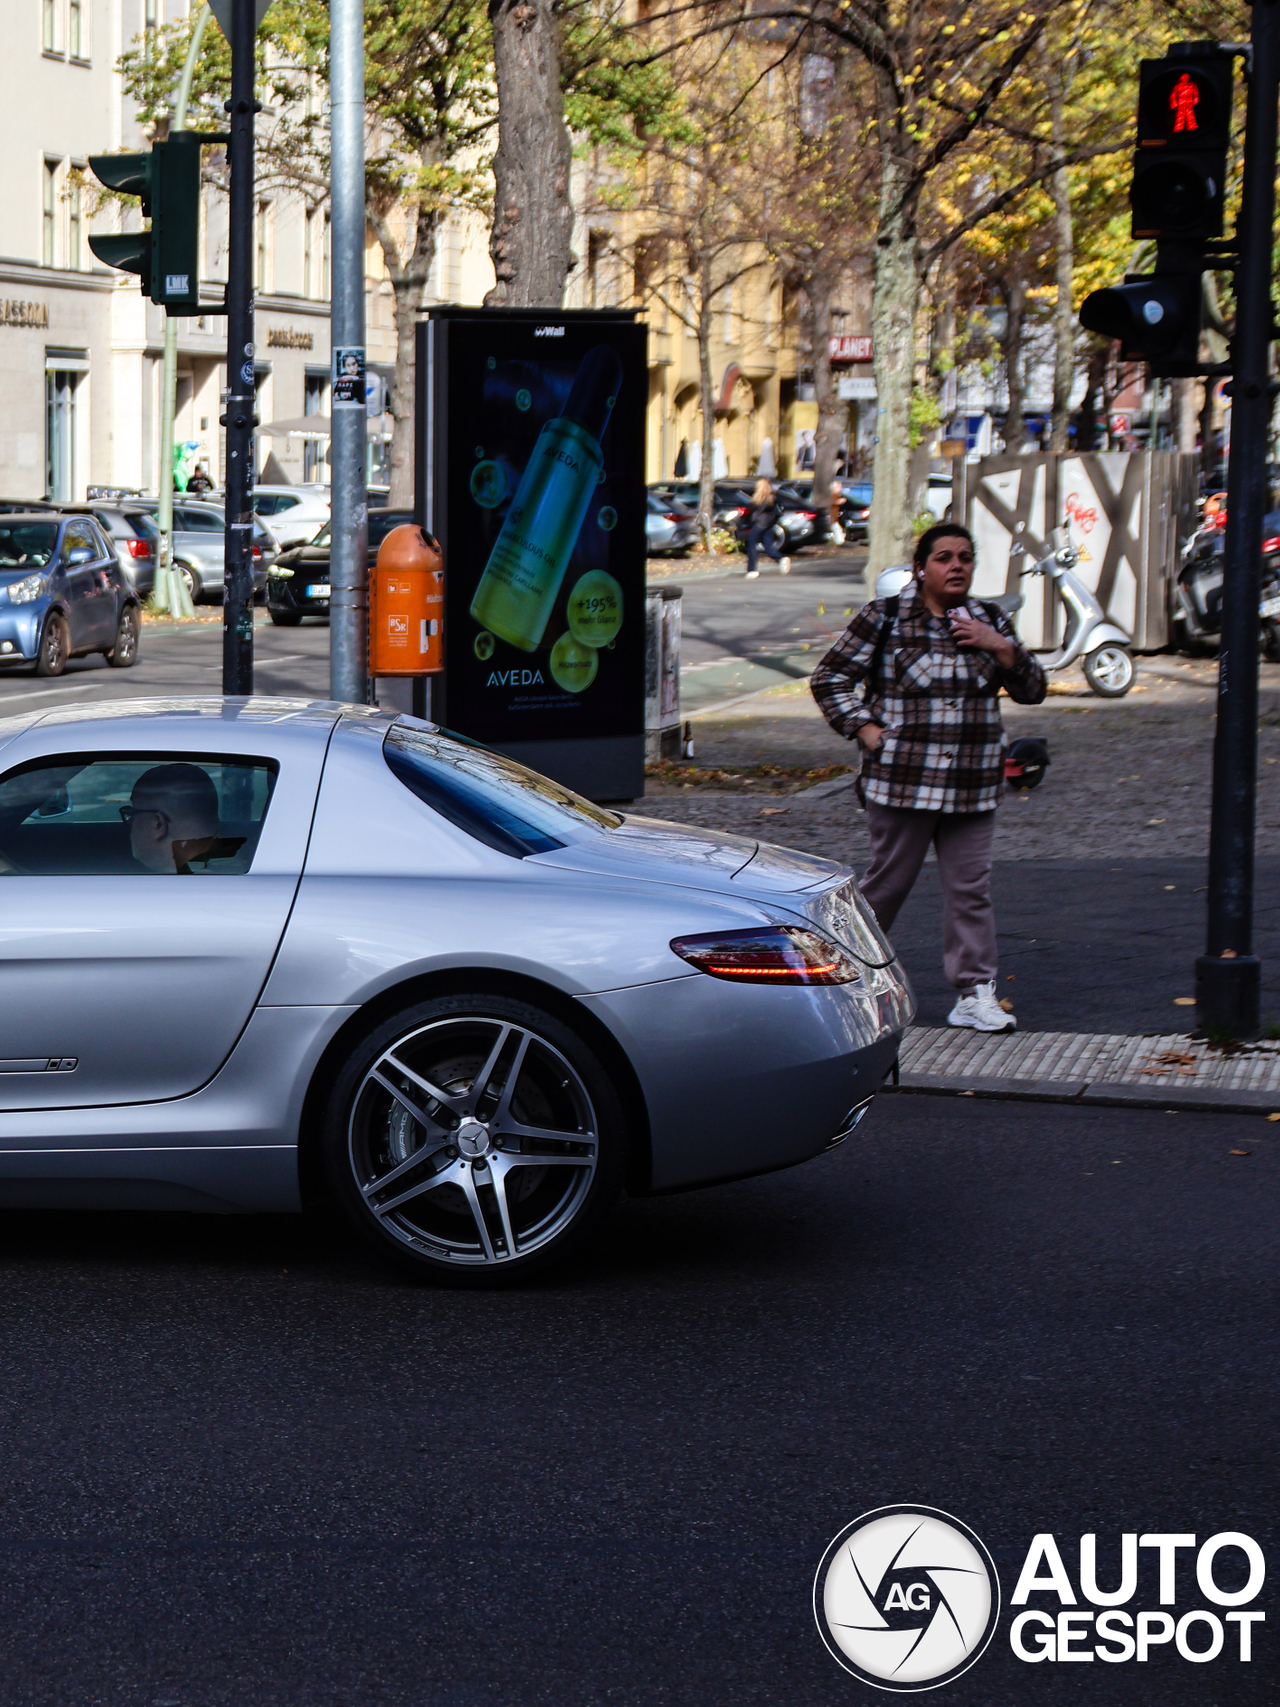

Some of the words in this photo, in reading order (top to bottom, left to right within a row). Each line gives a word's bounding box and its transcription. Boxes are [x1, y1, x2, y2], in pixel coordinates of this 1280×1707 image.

[166, 275, 189, 291] LMK
[545, 326, 565, 336] Wall
[829, 337, 872, 358] PLANET
[544, 447, 580, 473] AVEDA
[578, 596, 617, 613] +195%
[390, 618, 407, 632] BSR
[578, 616, 596, 624] mehr
[597, 615, 616, 623] Glanz
[486, 669, 544, 687] AVEDA
